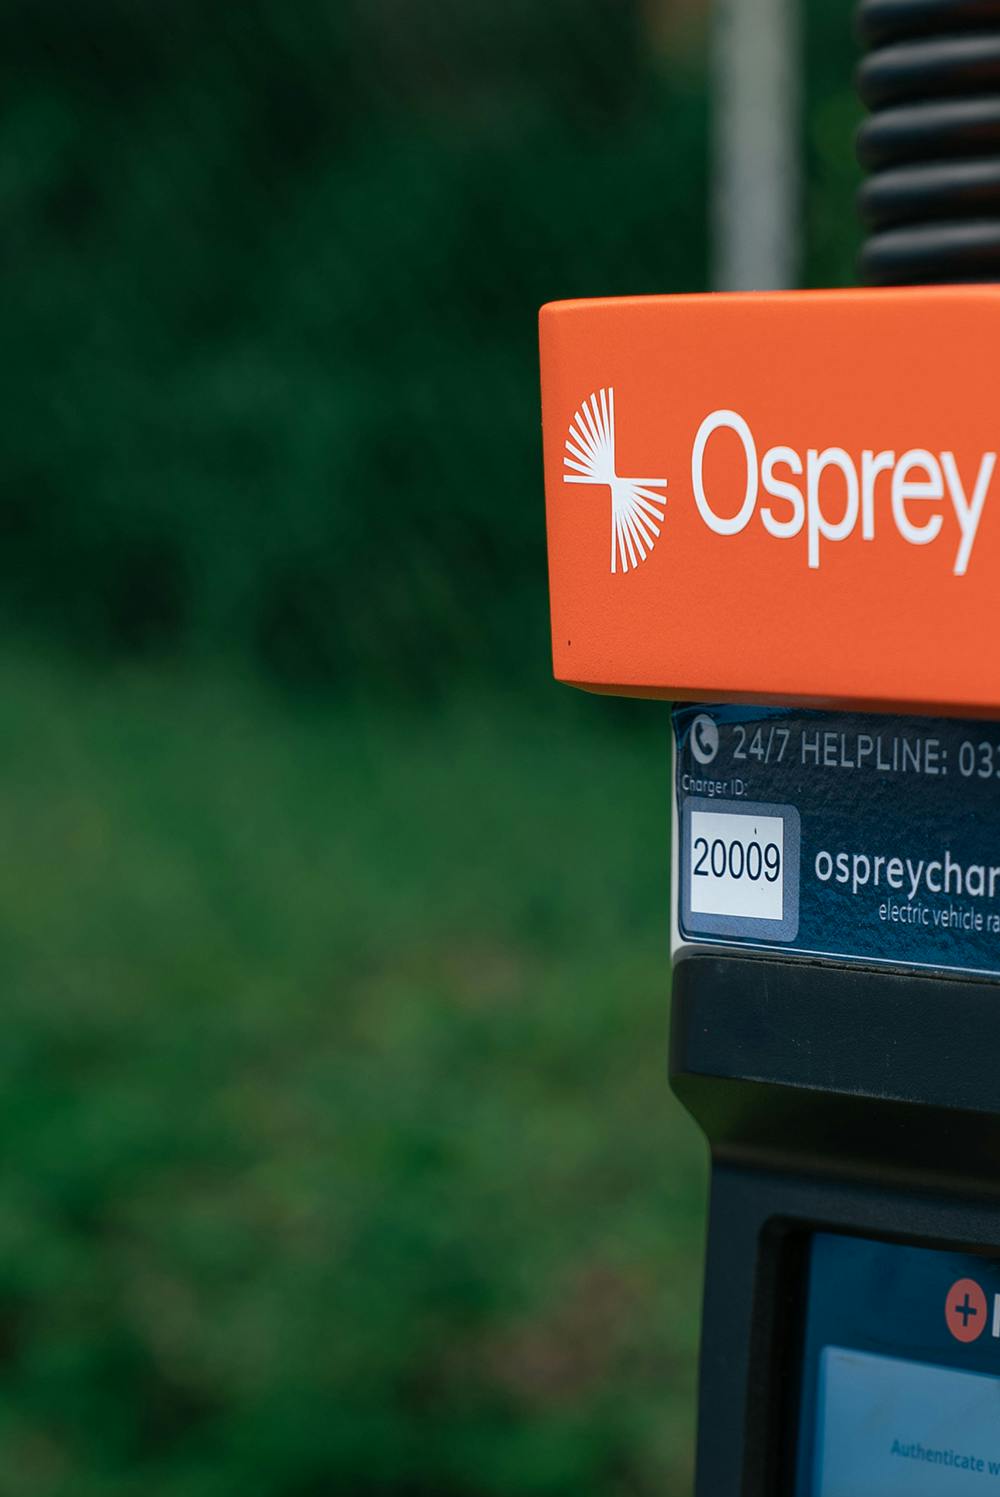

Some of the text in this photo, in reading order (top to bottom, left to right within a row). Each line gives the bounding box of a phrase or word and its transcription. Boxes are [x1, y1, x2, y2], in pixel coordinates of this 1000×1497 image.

[691, 409, 997, 576] Osprey
[732, 725, 790, 764] 24/7
[801, 731, 948, 775] HELPLINE:
[681, 774, 728, 797] Charger
[693, 837, 781, 883] 20009
[878, 898, 930, 926] electric
[932, 902, 984, 932] vehicle
[890, 1438, 985, 1473] Authenticate
